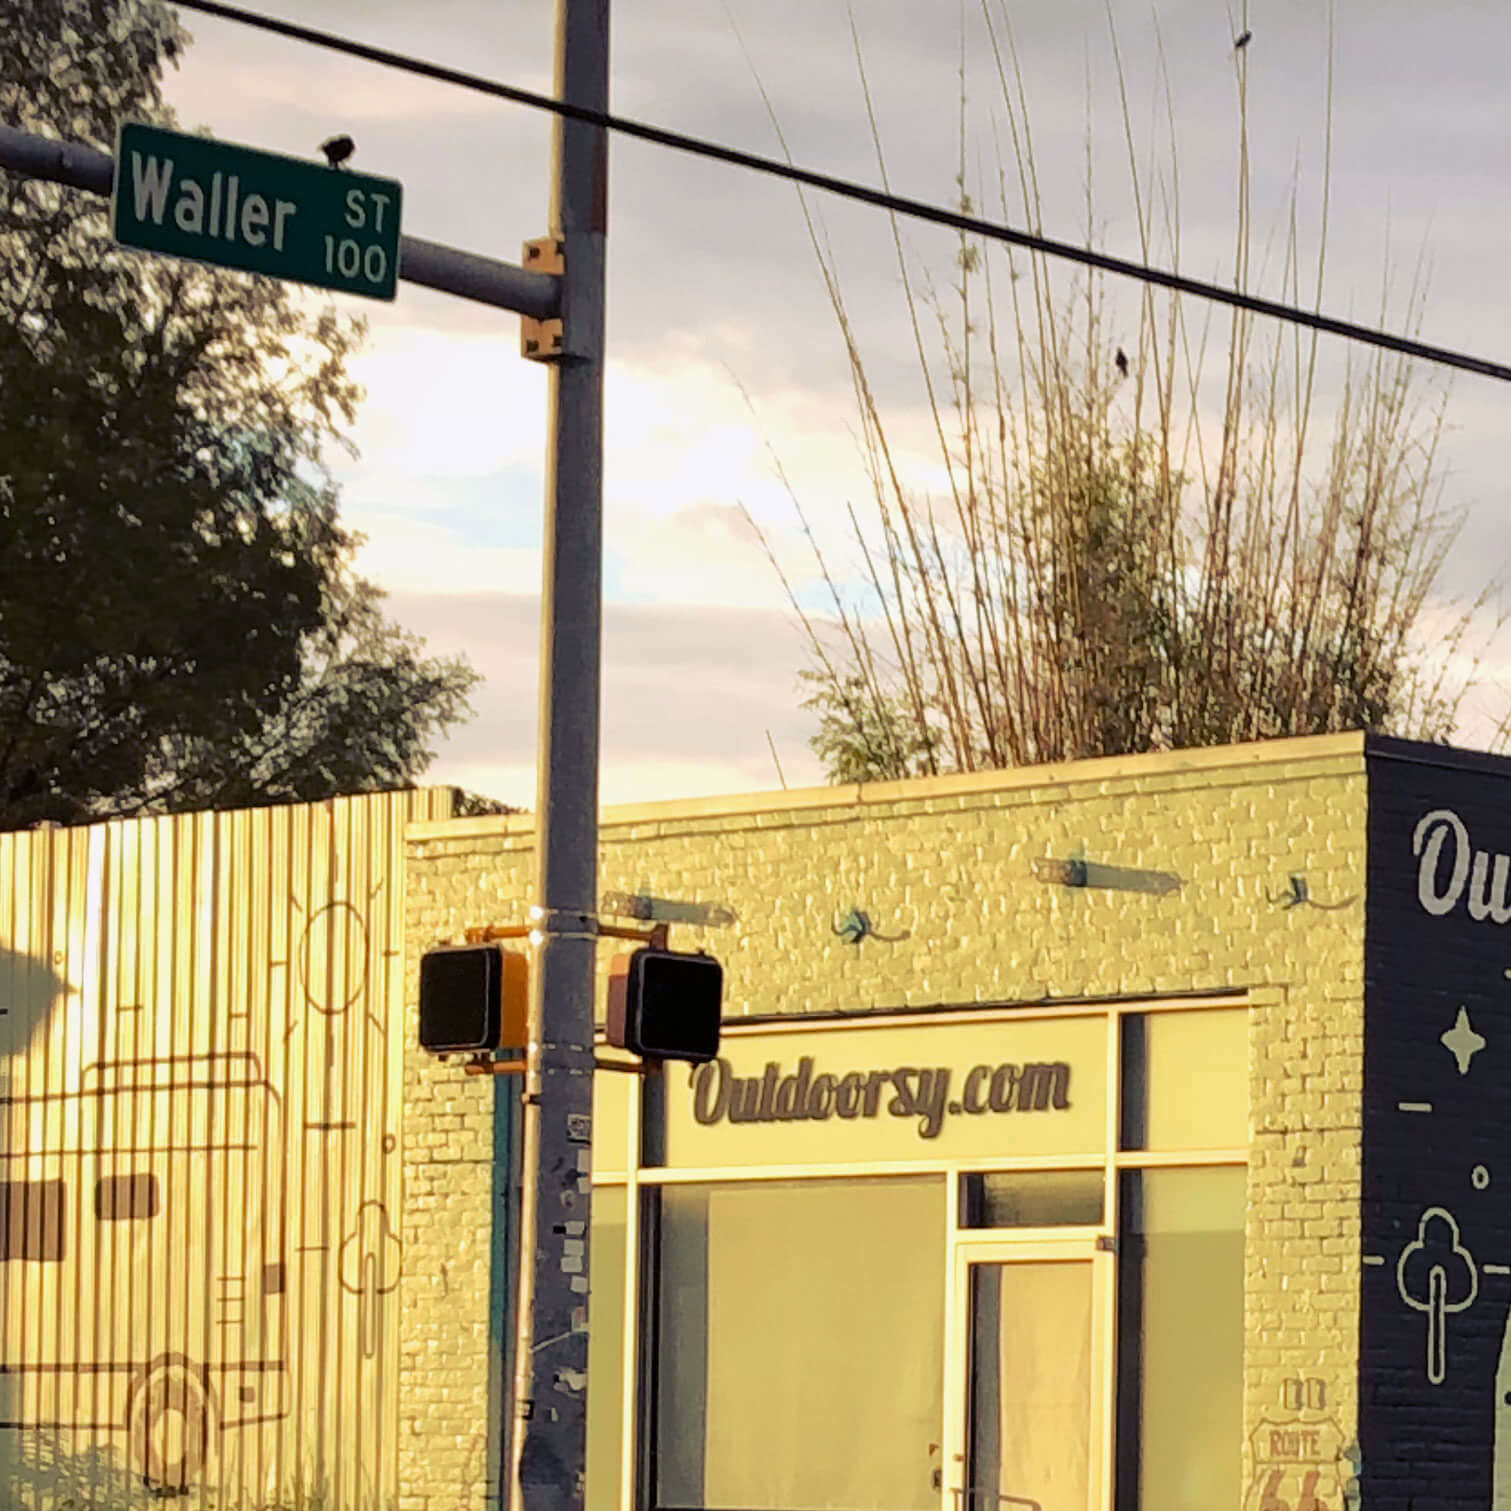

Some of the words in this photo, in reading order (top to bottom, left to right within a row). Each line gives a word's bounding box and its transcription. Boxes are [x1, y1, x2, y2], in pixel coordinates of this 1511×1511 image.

[131, 150, 297, 252] Waller
[344, 188, 391, 234] ST
[323, 234, 387, 284] 100
[689, 1056, 1072, 1139] Outdoorsy.com
[1269, 1430, 1321, 1456] ROUTE
